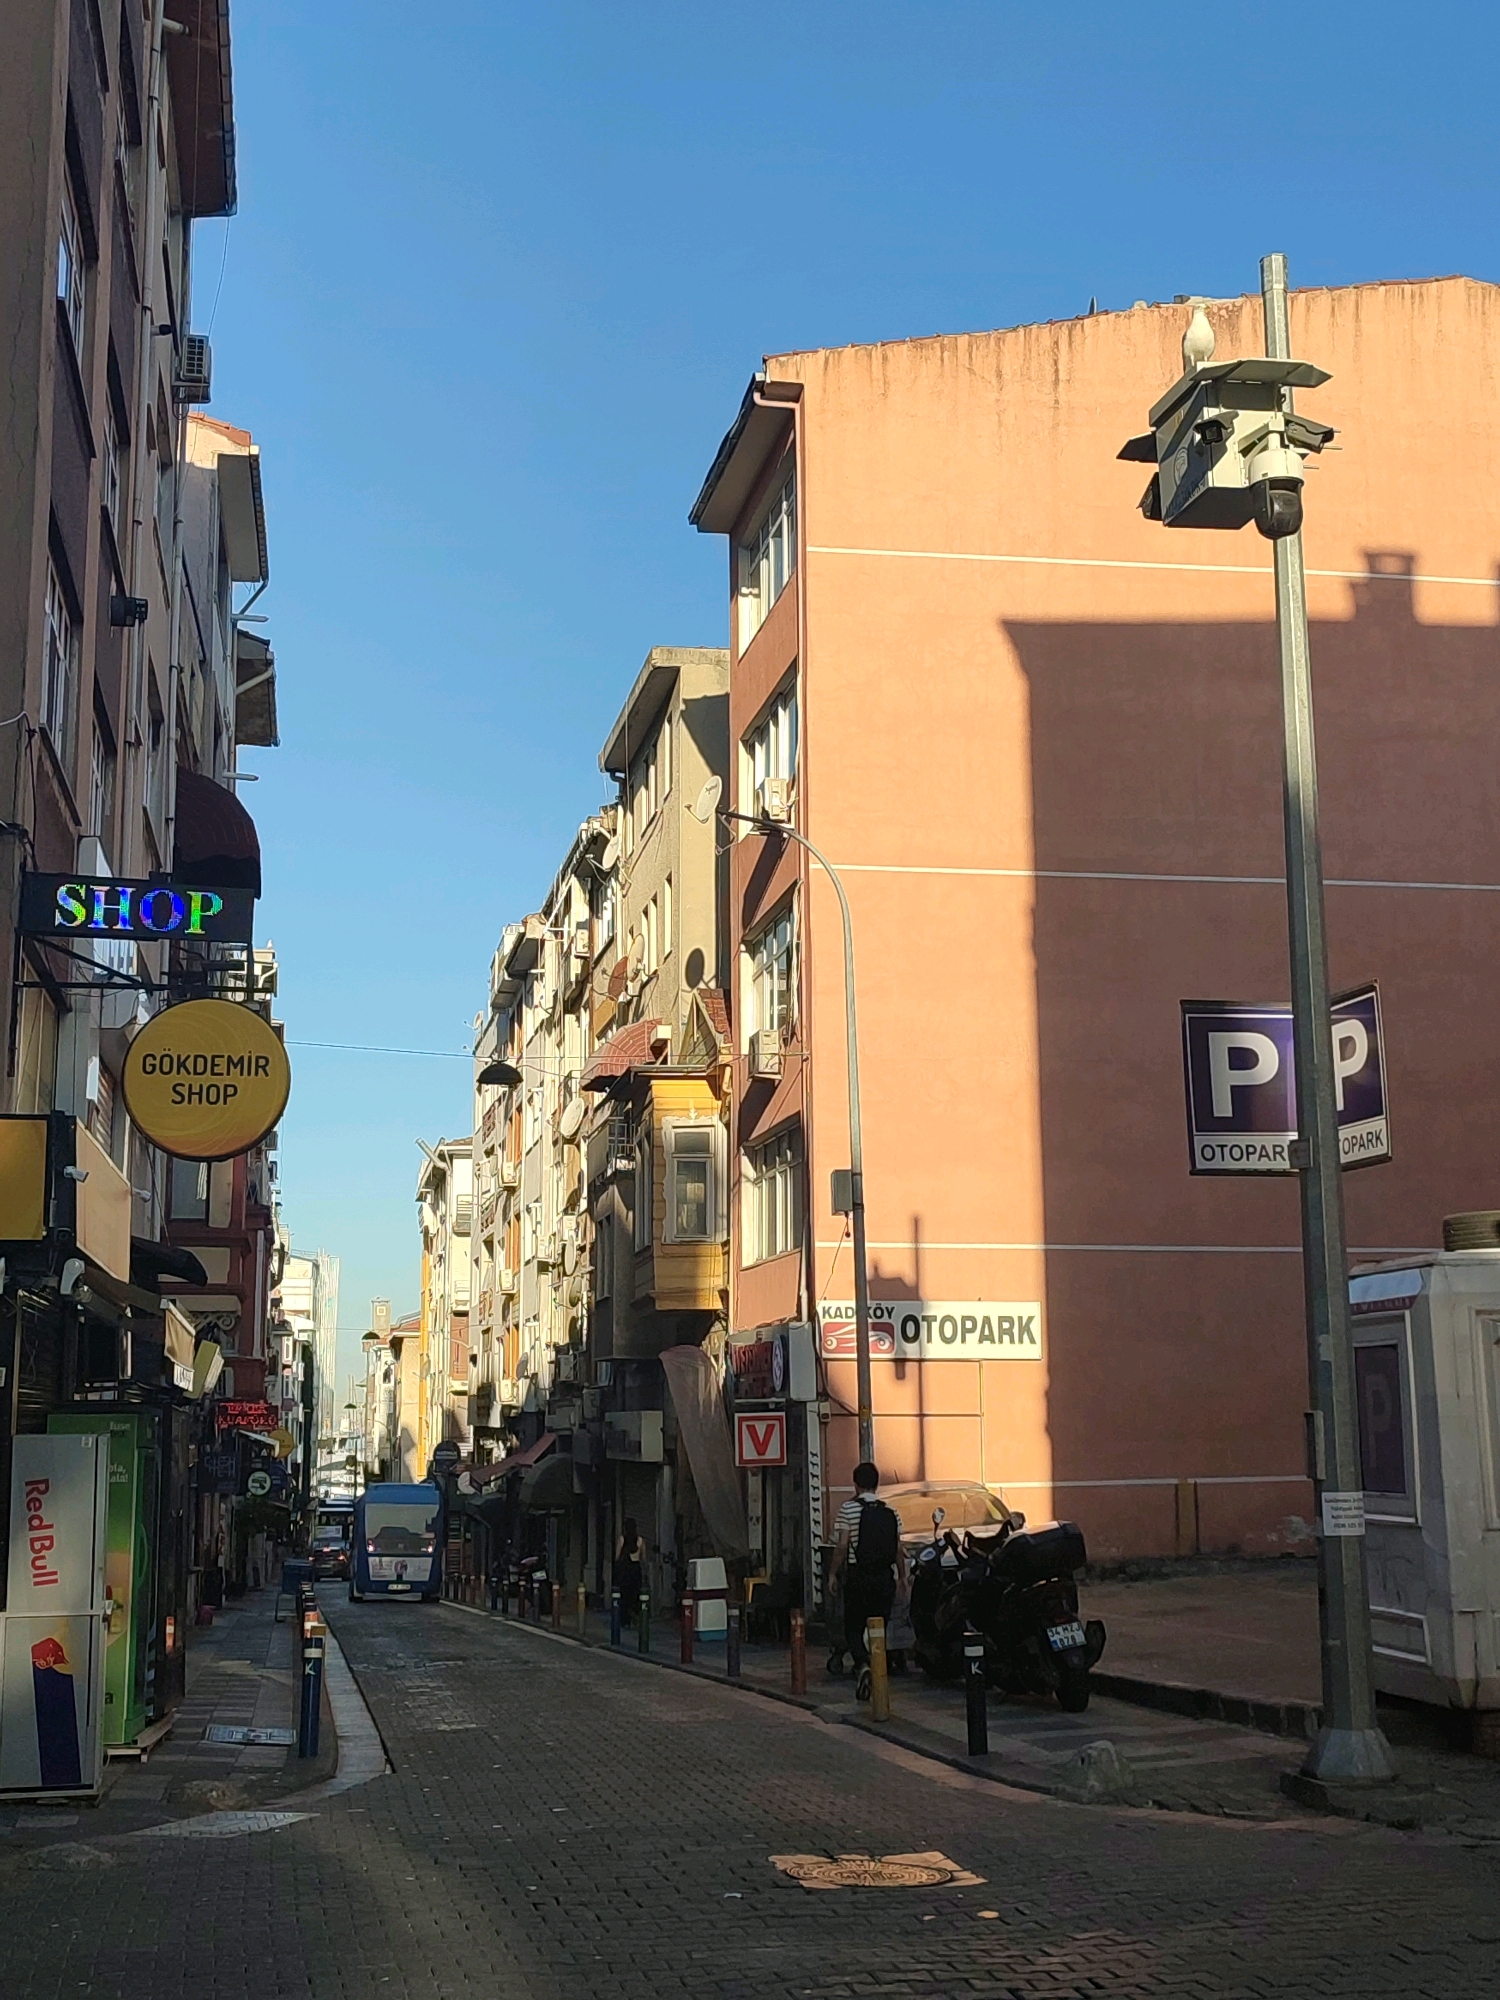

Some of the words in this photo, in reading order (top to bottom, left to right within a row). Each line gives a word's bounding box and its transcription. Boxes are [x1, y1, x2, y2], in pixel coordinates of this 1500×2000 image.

[54, 883, 224, 935] SHOP
[141, 1047, 270, 1077] GÖKDEMİR
[1207, 1031, 1279, 1118] P
[170, 1083, 239, 1106] SHOP
[1200, 1143, 1290, 1163] OTOPAR
[1338, 1128, 1384, 1157] OPARK
[900, 1314, 1037, 1345] OTOPARK
[745, 1423, 776, 1456] V
[24, 1478, 54, 1532] Red
[29, 1535, 59, 1587] Bull
